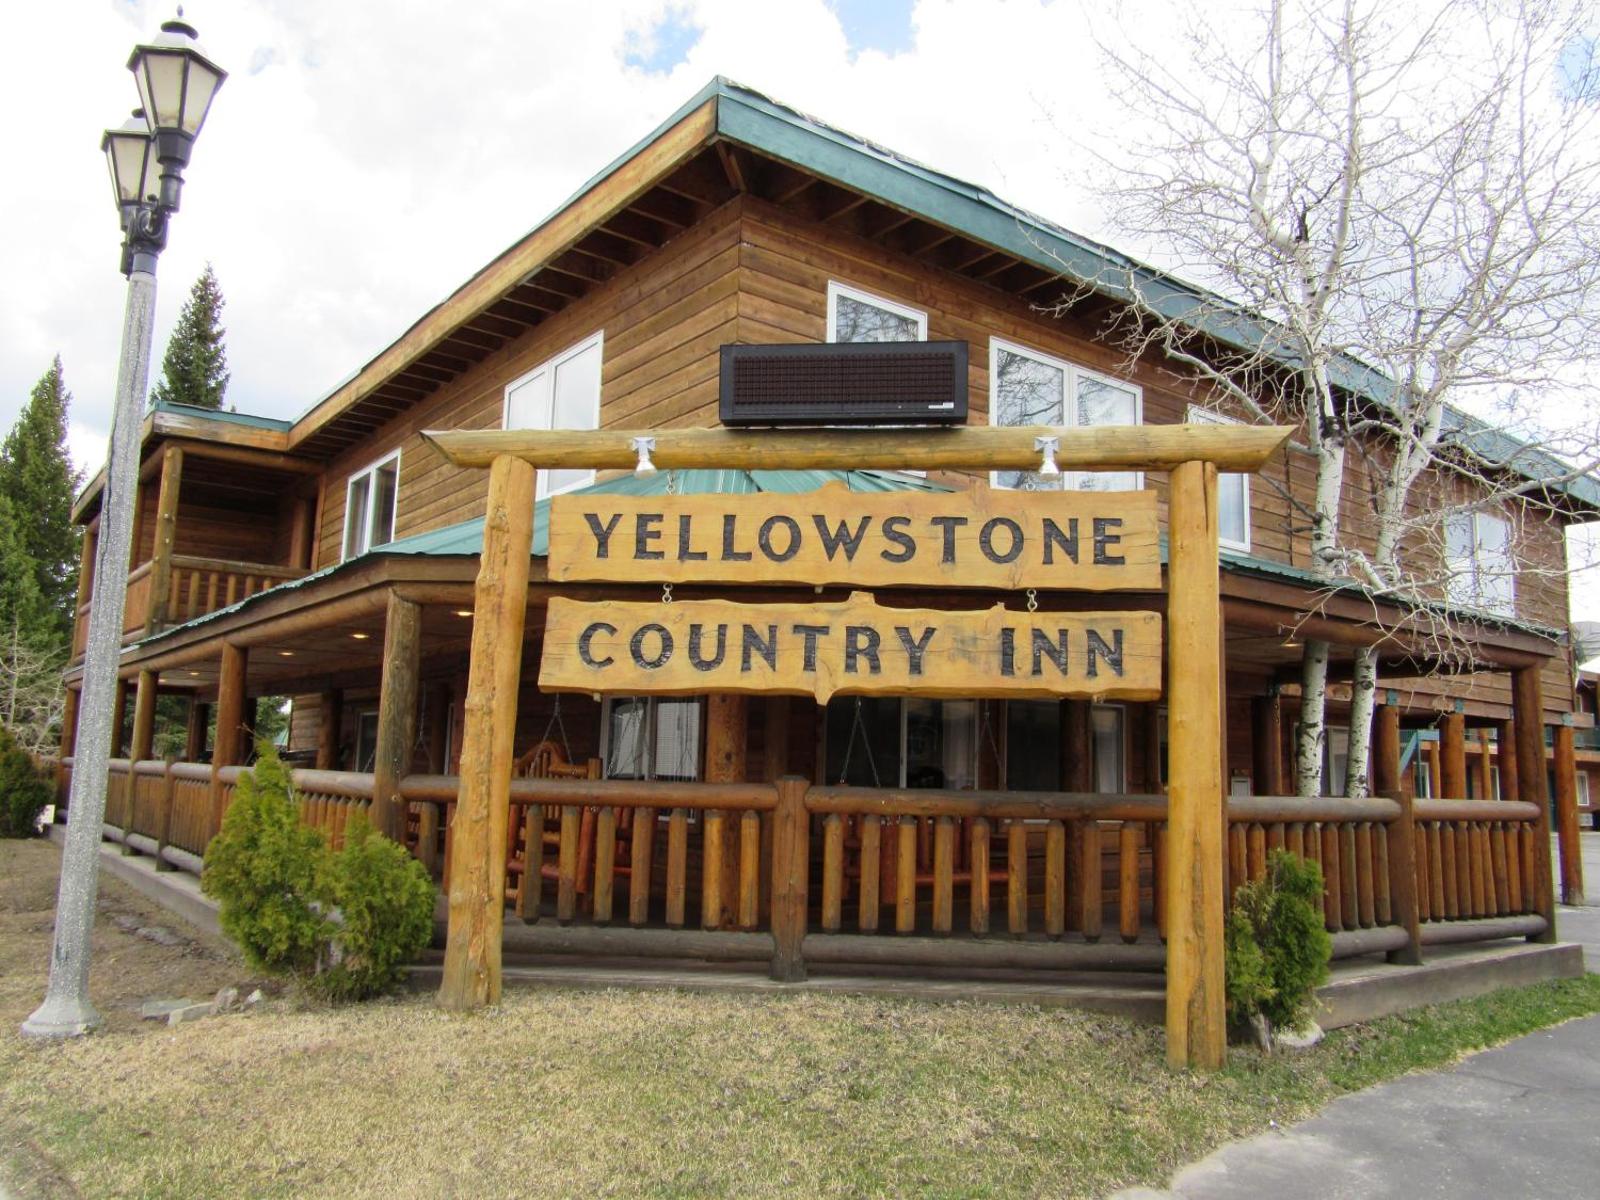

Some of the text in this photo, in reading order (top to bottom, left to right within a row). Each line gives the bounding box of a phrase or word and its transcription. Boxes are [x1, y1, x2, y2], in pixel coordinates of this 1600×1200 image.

[584, 513, 1125, 565] YELLOWSTONE
[578, 622, 1124, 678] COUNTRY INN
